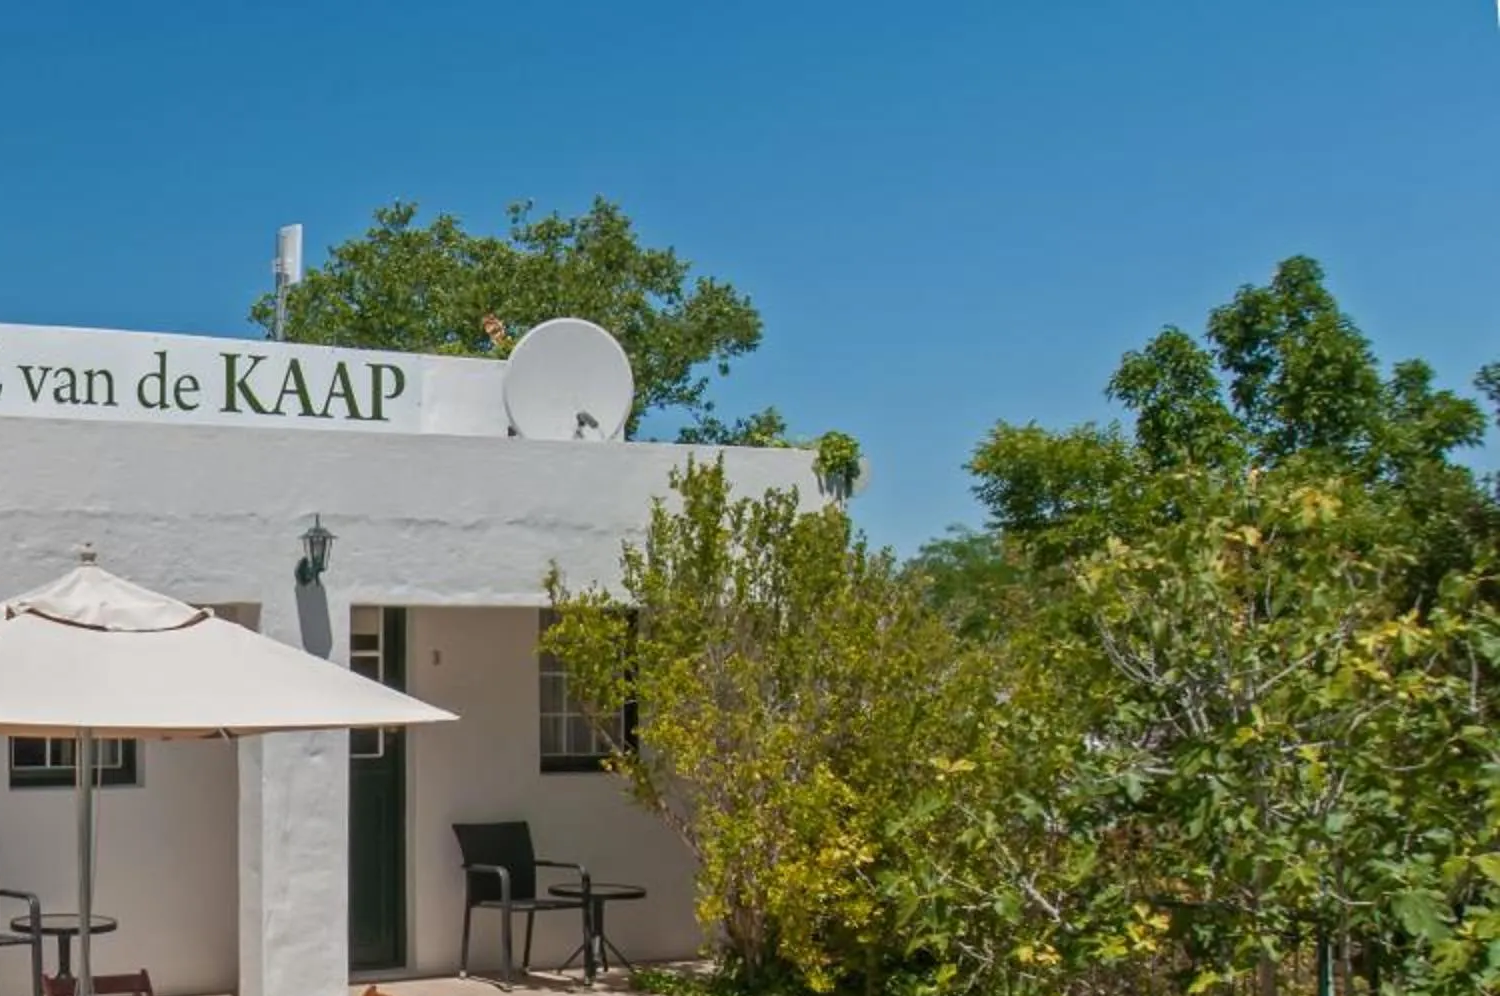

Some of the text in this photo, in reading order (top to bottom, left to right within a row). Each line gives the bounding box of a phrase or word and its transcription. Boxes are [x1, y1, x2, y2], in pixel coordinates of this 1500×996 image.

[17, 364, 118, 407] van
[136, 350, 201, 412] de
[219, 352, 406, 422] KAAP
